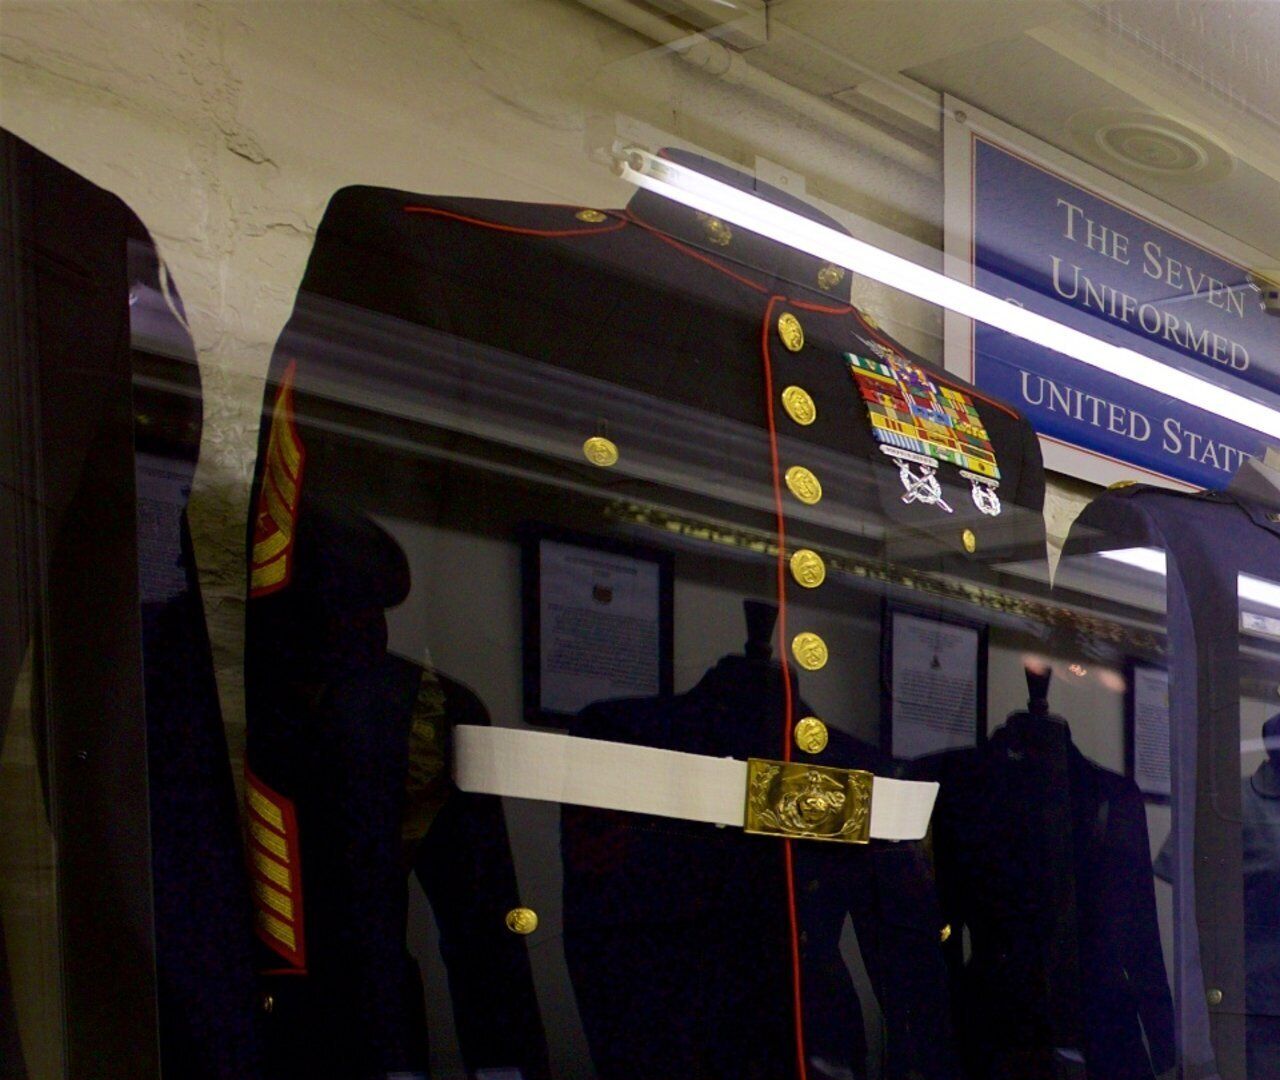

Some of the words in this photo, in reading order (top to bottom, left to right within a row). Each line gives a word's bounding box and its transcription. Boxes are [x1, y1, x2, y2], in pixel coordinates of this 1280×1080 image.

[1050, 254, 1250, 372] UNIFORMED
[1057, 198, 1130, 266] THE
[1143, 241, 1246, 319] SEVEN
[1019, 370, 1151, 442] UNITED
[1163, 418, 1257, 474] STAT
